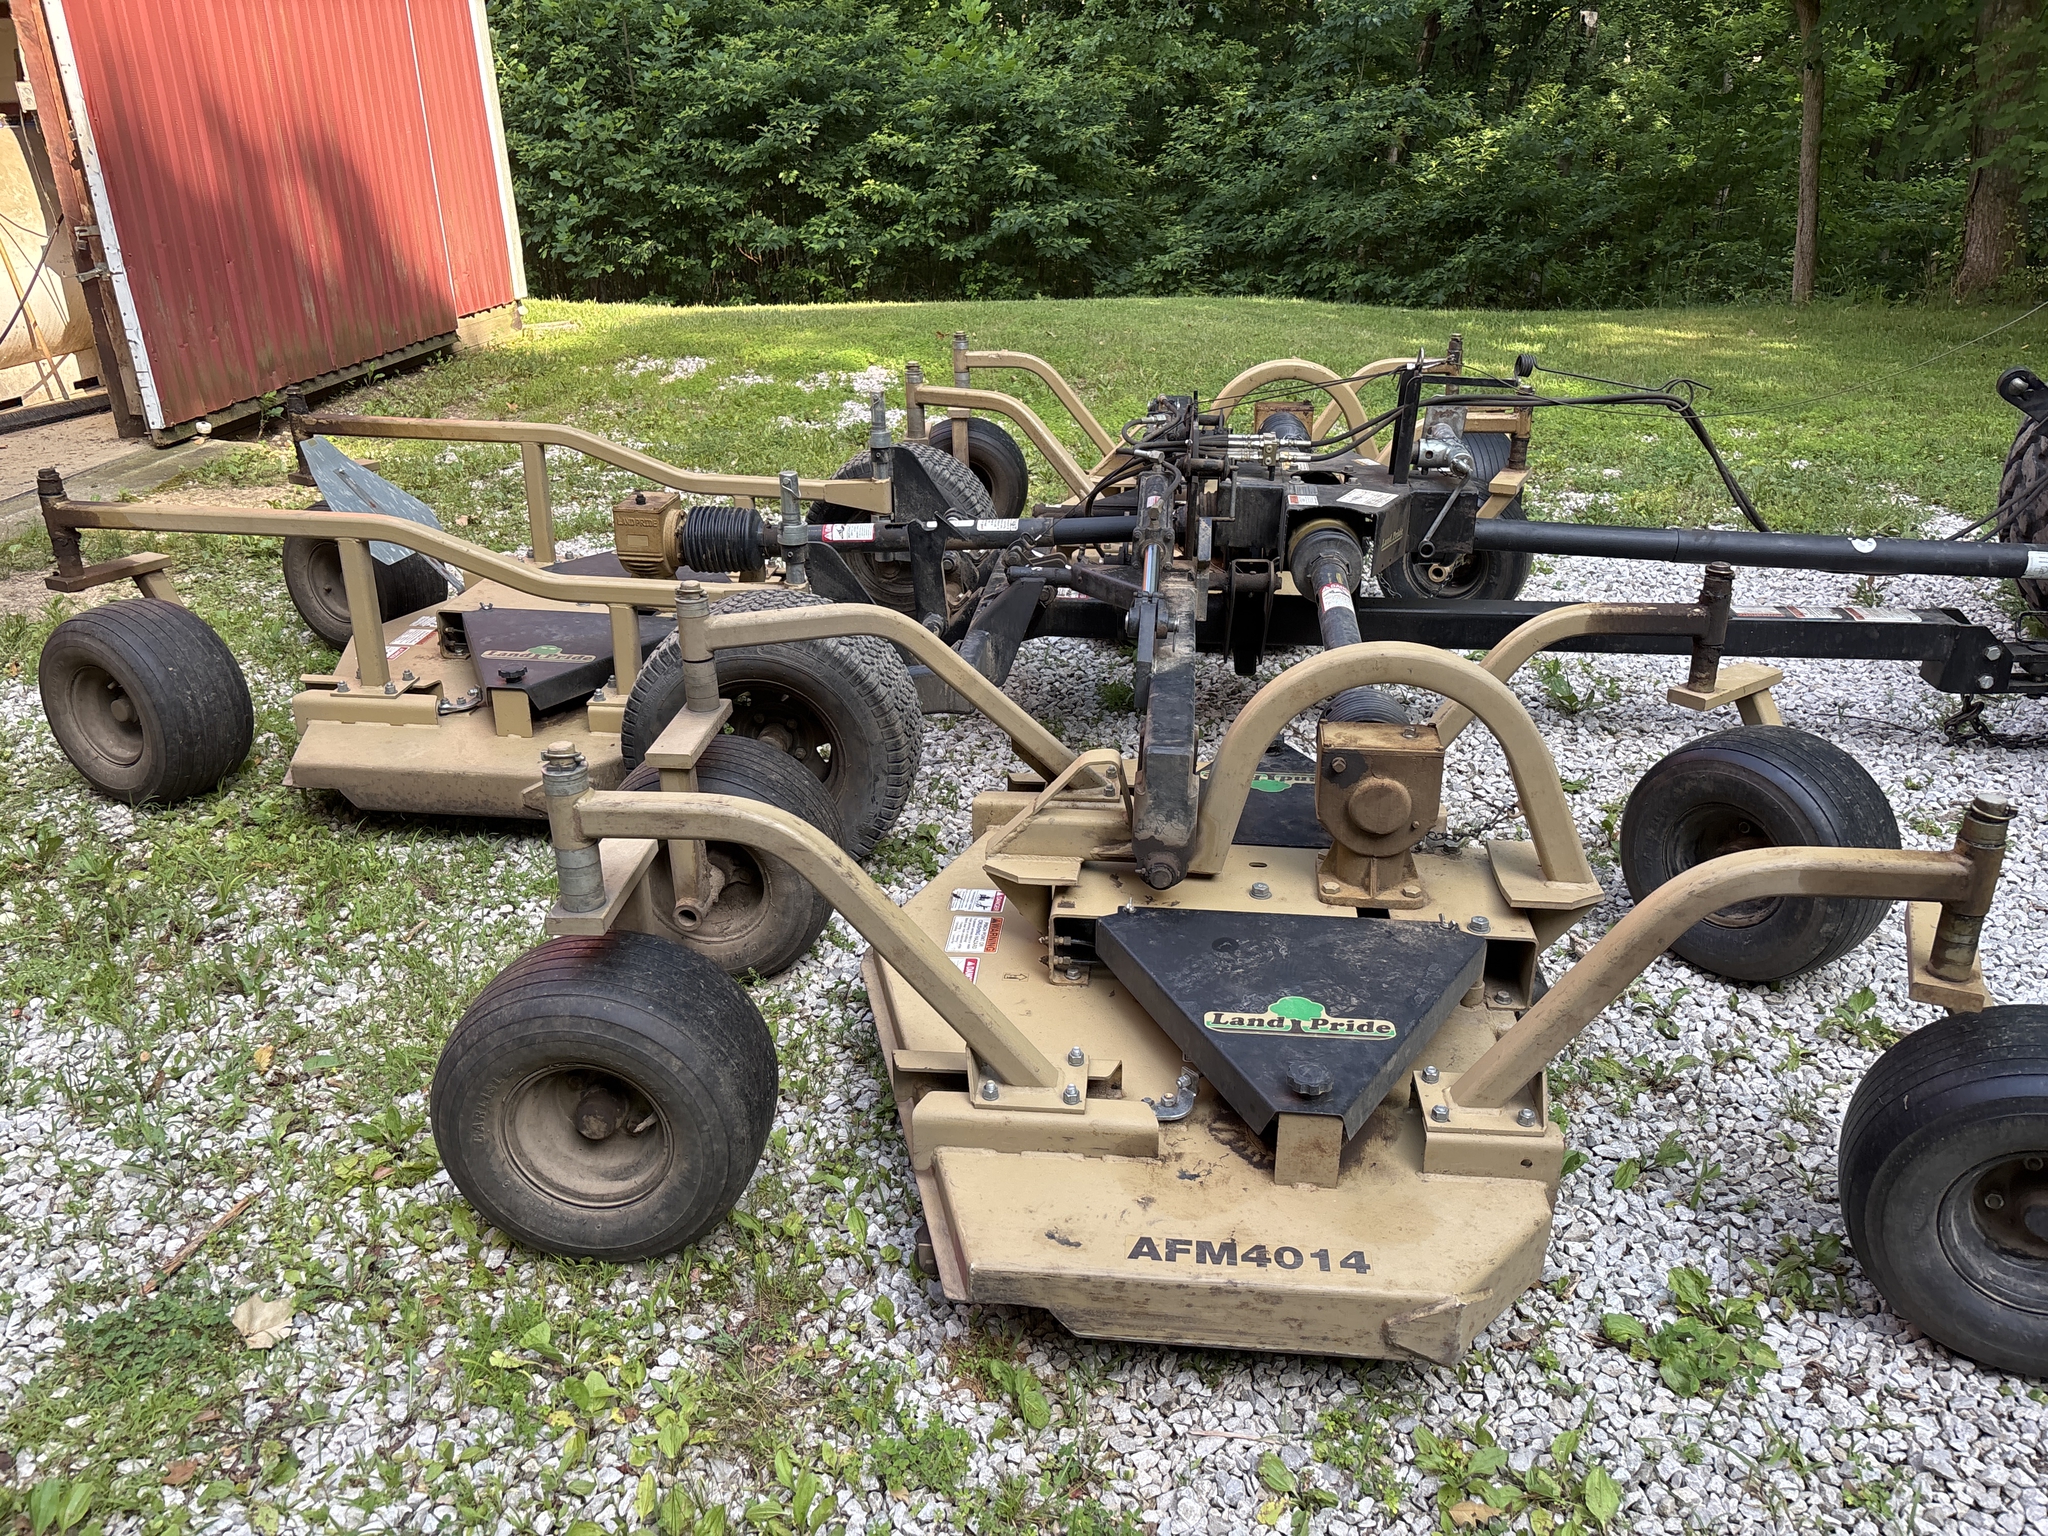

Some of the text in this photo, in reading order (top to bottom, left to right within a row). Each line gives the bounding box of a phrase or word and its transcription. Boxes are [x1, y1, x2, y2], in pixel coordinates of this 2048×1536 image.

[487, 650, 593, 661] Land Pride
[985, 922, 1001, 952] WARNING
[1211, 1012, 1391, 1034] Land Pride
[1127, 1236, 1371, 1275] AFM4014
